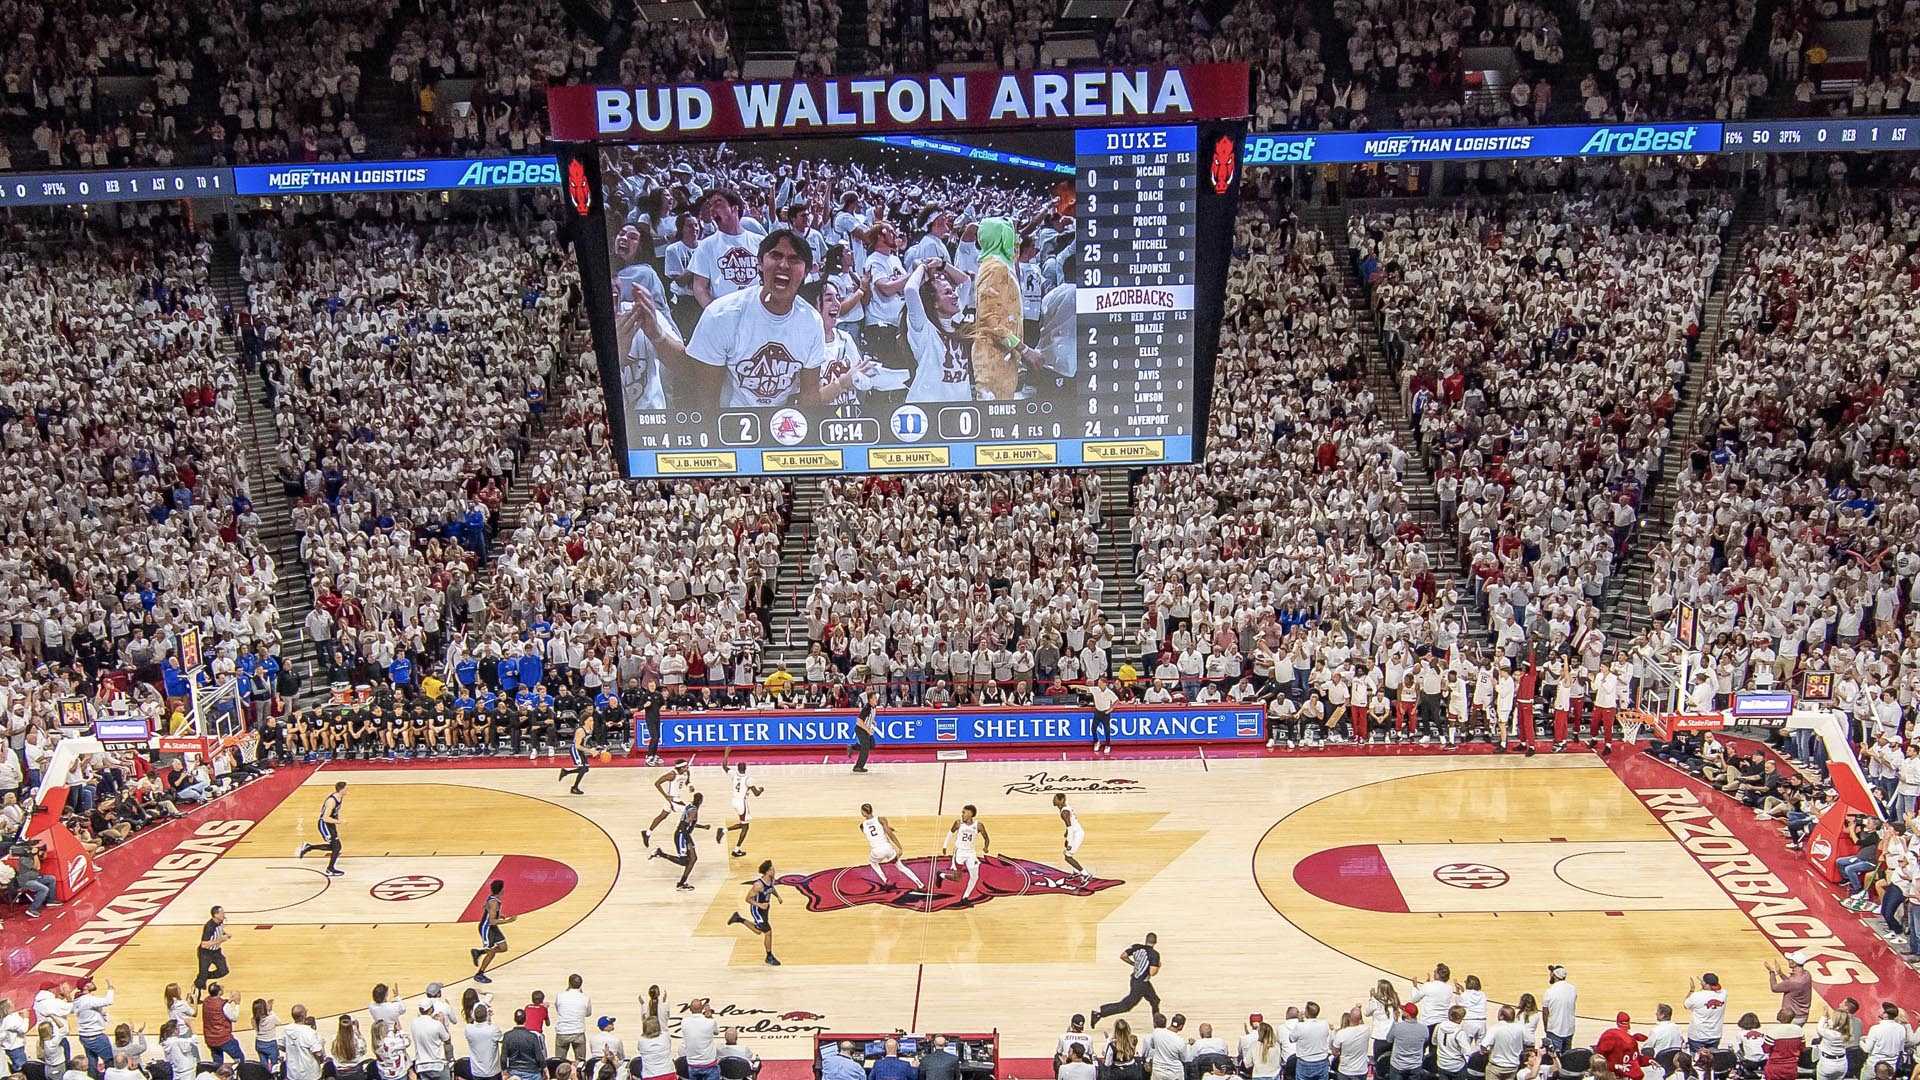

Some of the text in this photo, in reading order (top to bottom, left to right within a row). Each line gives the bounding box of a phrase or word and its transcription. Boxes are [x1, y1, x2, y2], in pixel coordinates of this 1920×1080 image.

[596, 70, 1193, 133] BUD WALTON ARENA
[1107, 132, 1166, 149] DUKE
[1580, 128, 1695, 152] ArcBest
[1726, 128, 1906, 144] FG% 50 3PT% 0 REB 1 AST
[1365, 136, 1531, 155] MORE THAN LOGISTICS
[1110, 153, 1190, 165] PTS REB AST FLS
[270, 169, 426, 186] MORE THAN LOGISTICS
[1136, 166, 1165, 177] MCCAIN
[1088, 170, 1097, 188] 0
[1114, 178, 1185, 190] 0 0 0 0
[16, 184, 26, 197] 0
[42, 183, 66, 196] 3PT%
[80, 182, 89, 195] 0
[106, 180, 120, 193] REB
[130, 180, 138, 192] 1
[153, 178, 166, 190] AST
[175, 178, 184, 190] 0
[197, 176, 207, 188] TO
[213, 176, 220, 188] 1
[1138, 191, 1163, 202] ROACH
[1088, 195, 1097, 212] 3
[1114, 202, 1185, 214] 0 0 0 0
[1133, 216, 1168, 227] PROCTOR
[1088, 220, 1097, 237] 5
[1114, 226, 1185, 239] 0 0 0 0
[1132, 240, 1168, 250] MITCHELL
[1084, 244, 1101, 261] 25
[1114, 251, 1184, 263] 0 1 0 0
[1130, 264, 1170, 274] FILIPOWSKI
[1084, 269, 1101, 286] 30
[1114, 274, 1184, 286] 0 0 0 0
[1096, 289, 1174, 311] RAZORBACKS
[1110, 312, 1187, 322] PTS REB AST FLS
[1135, 324, 1164, 334] BRAZILE
[1089, 328, 1097, 345] 2
[1114, 334, 1183, 346] 0 0 0 0
[1140, 347, 1159, 357] ELLIS
[736, 355, 803, 377] CAMP
[1089, 352, 1097, 368] 3
[1114, 358, 1183, 369] 0 0 0 0
[1138, 370, 1160, 380] DAVIS
[1088, 375, 1097, 391] 4
[1114, 380, 1183, 392] 0 0 0 0
[1134, 392, 1163, 403] LAWSON
[988, 405, 1016, 415] BONUS
[1088, 398, 1097, 414] 8
[1114, 404, 1183, 414] 0 1 0 0
[640, 414, 667, 425] BONUS
[960, 412, 971, 435] 0
[1128, 415, 1169, 426] DAVENPORT
[740, 418, 751, 440] 2
[828, 424, 863, 441] 19:14
[990, 424, 1060, 439] TOL 4 FLS 0
[1085, 421, 1101, 437] 24
[1114, 426, 1183, 437] 0 0 0 0
[642, 434, 708, 447] TOL 4 FLS 0
[1013, 450, 1037, 459] HUNT
[1120, 447, 1145, 455] HUNT
[694, 458, 717, 467] HUNT
[800, 456, 824, 465] HUNT
[674, 720, 915, 742] SHELTER INSURNCE
[974, 718, 1071, 739] SHELTER
[870, 826, 878, 837] 2
[962, 833, 973, 842] 24
[1635, 787, 1880, 985] RAZORBACKS
[28, 820, 257, 977] ARKANSAS
